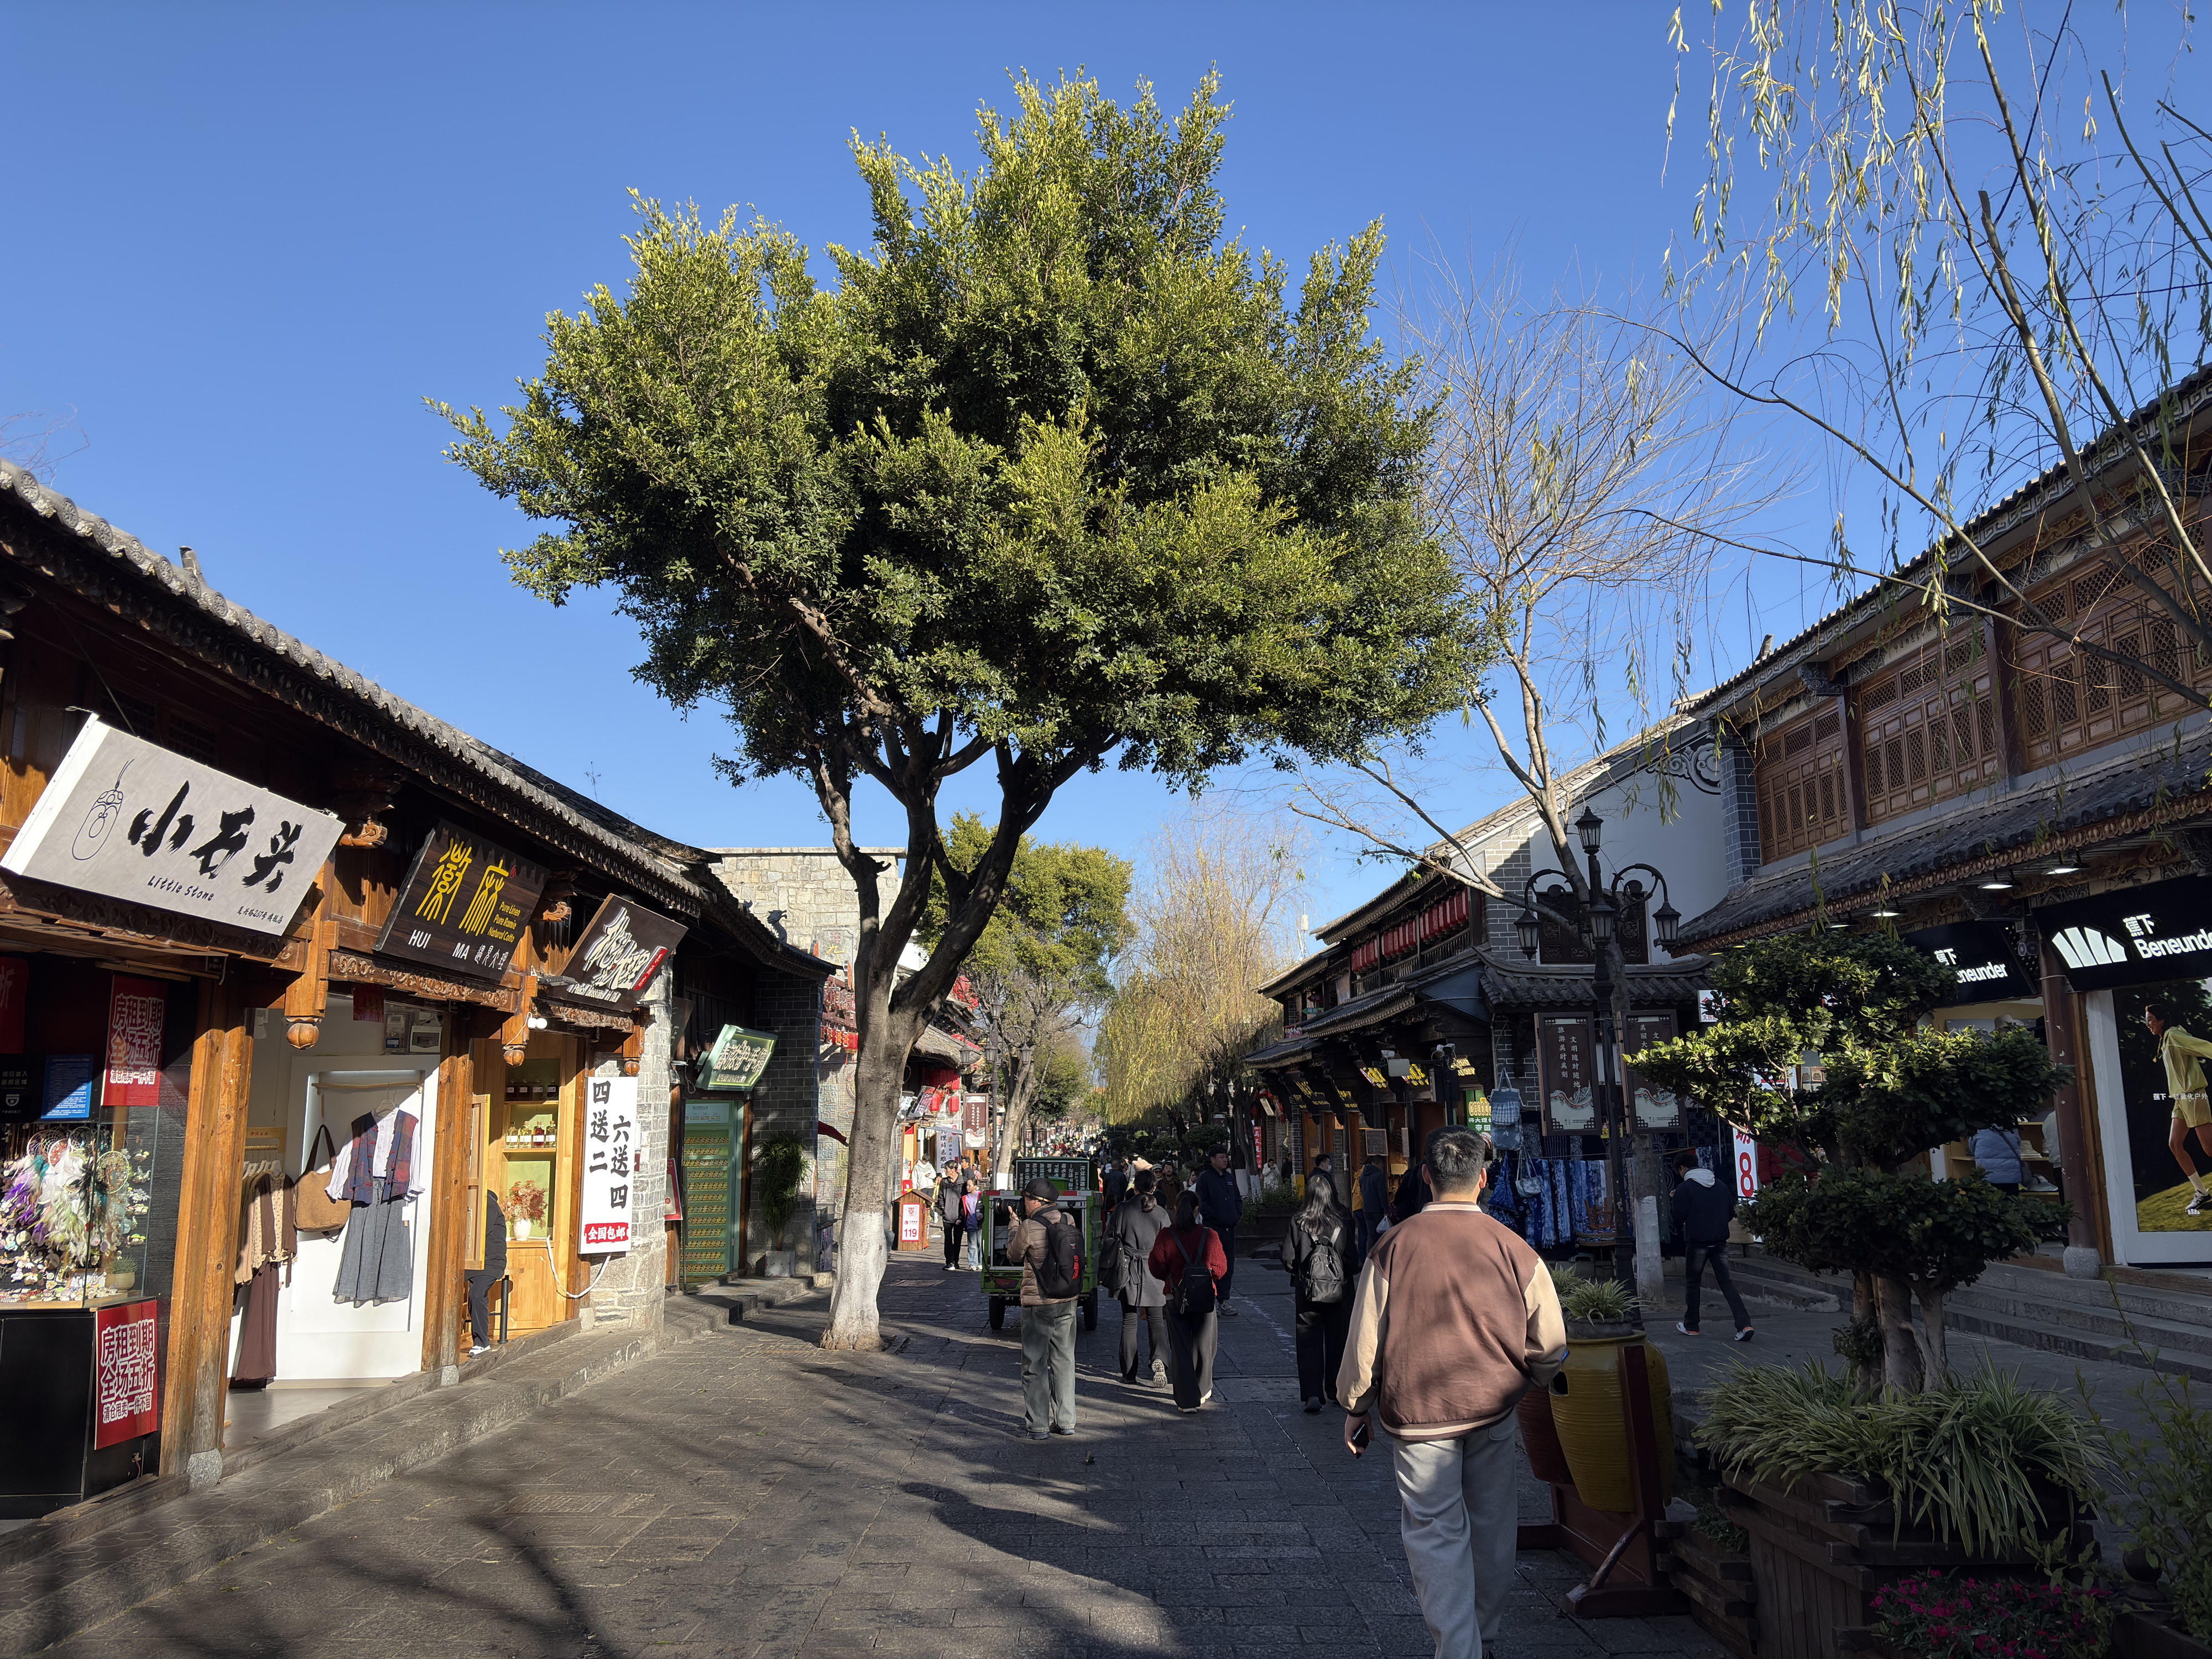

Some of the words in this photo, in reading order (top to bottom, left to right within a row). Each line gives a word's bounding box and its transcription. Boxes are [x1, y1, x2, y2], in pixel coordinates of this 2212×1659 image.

[127, 780, 303, 894] 小石头
[147, 875, 182, 893] Little
[184, 885, 215, 901] Stone
[493, 914, 504, 926] Pure
[503, 917, 517, 930] Ramie
[499, 901, 509, 912] Pure
[508, 905, 521, 917] Linen
[487, 927, 505, 940] Natural
[504, 931, 515, 943] Cotto
[2122, 914, 2154, 937] 蕉下
[408, 930, 431, 948] HUI
[452, 942, 470, 959] MA
[572, 984, 587, 996] Peach
[113, 993, 164, 1032] 房租到期
[110, 1029, 161, 1066] 全场五折
[1557, 1026, 1568, 1078] 旅游美时美刻
[1570, 1036, 1581, 1088] 文明随时随地
[110, 1067, 134, 1084] 清仓甩卖
[133, 1067, 156, 1085] 一件不留
[589, 1081, 611, 1173] 四送二
[611, 1115, 631, 1209] 六送四
[588, 1226, 625, 1240] 全国包邮
[904, 1229, 917, 1237] 119
[101, 1319, 154, 1366] 房租到期
[101, 1357, 155, 1403] 全场五折
[103, 1399, 128, 1423] 清仓甩卖
[128, 1392, 152, 1415] 一件不留
